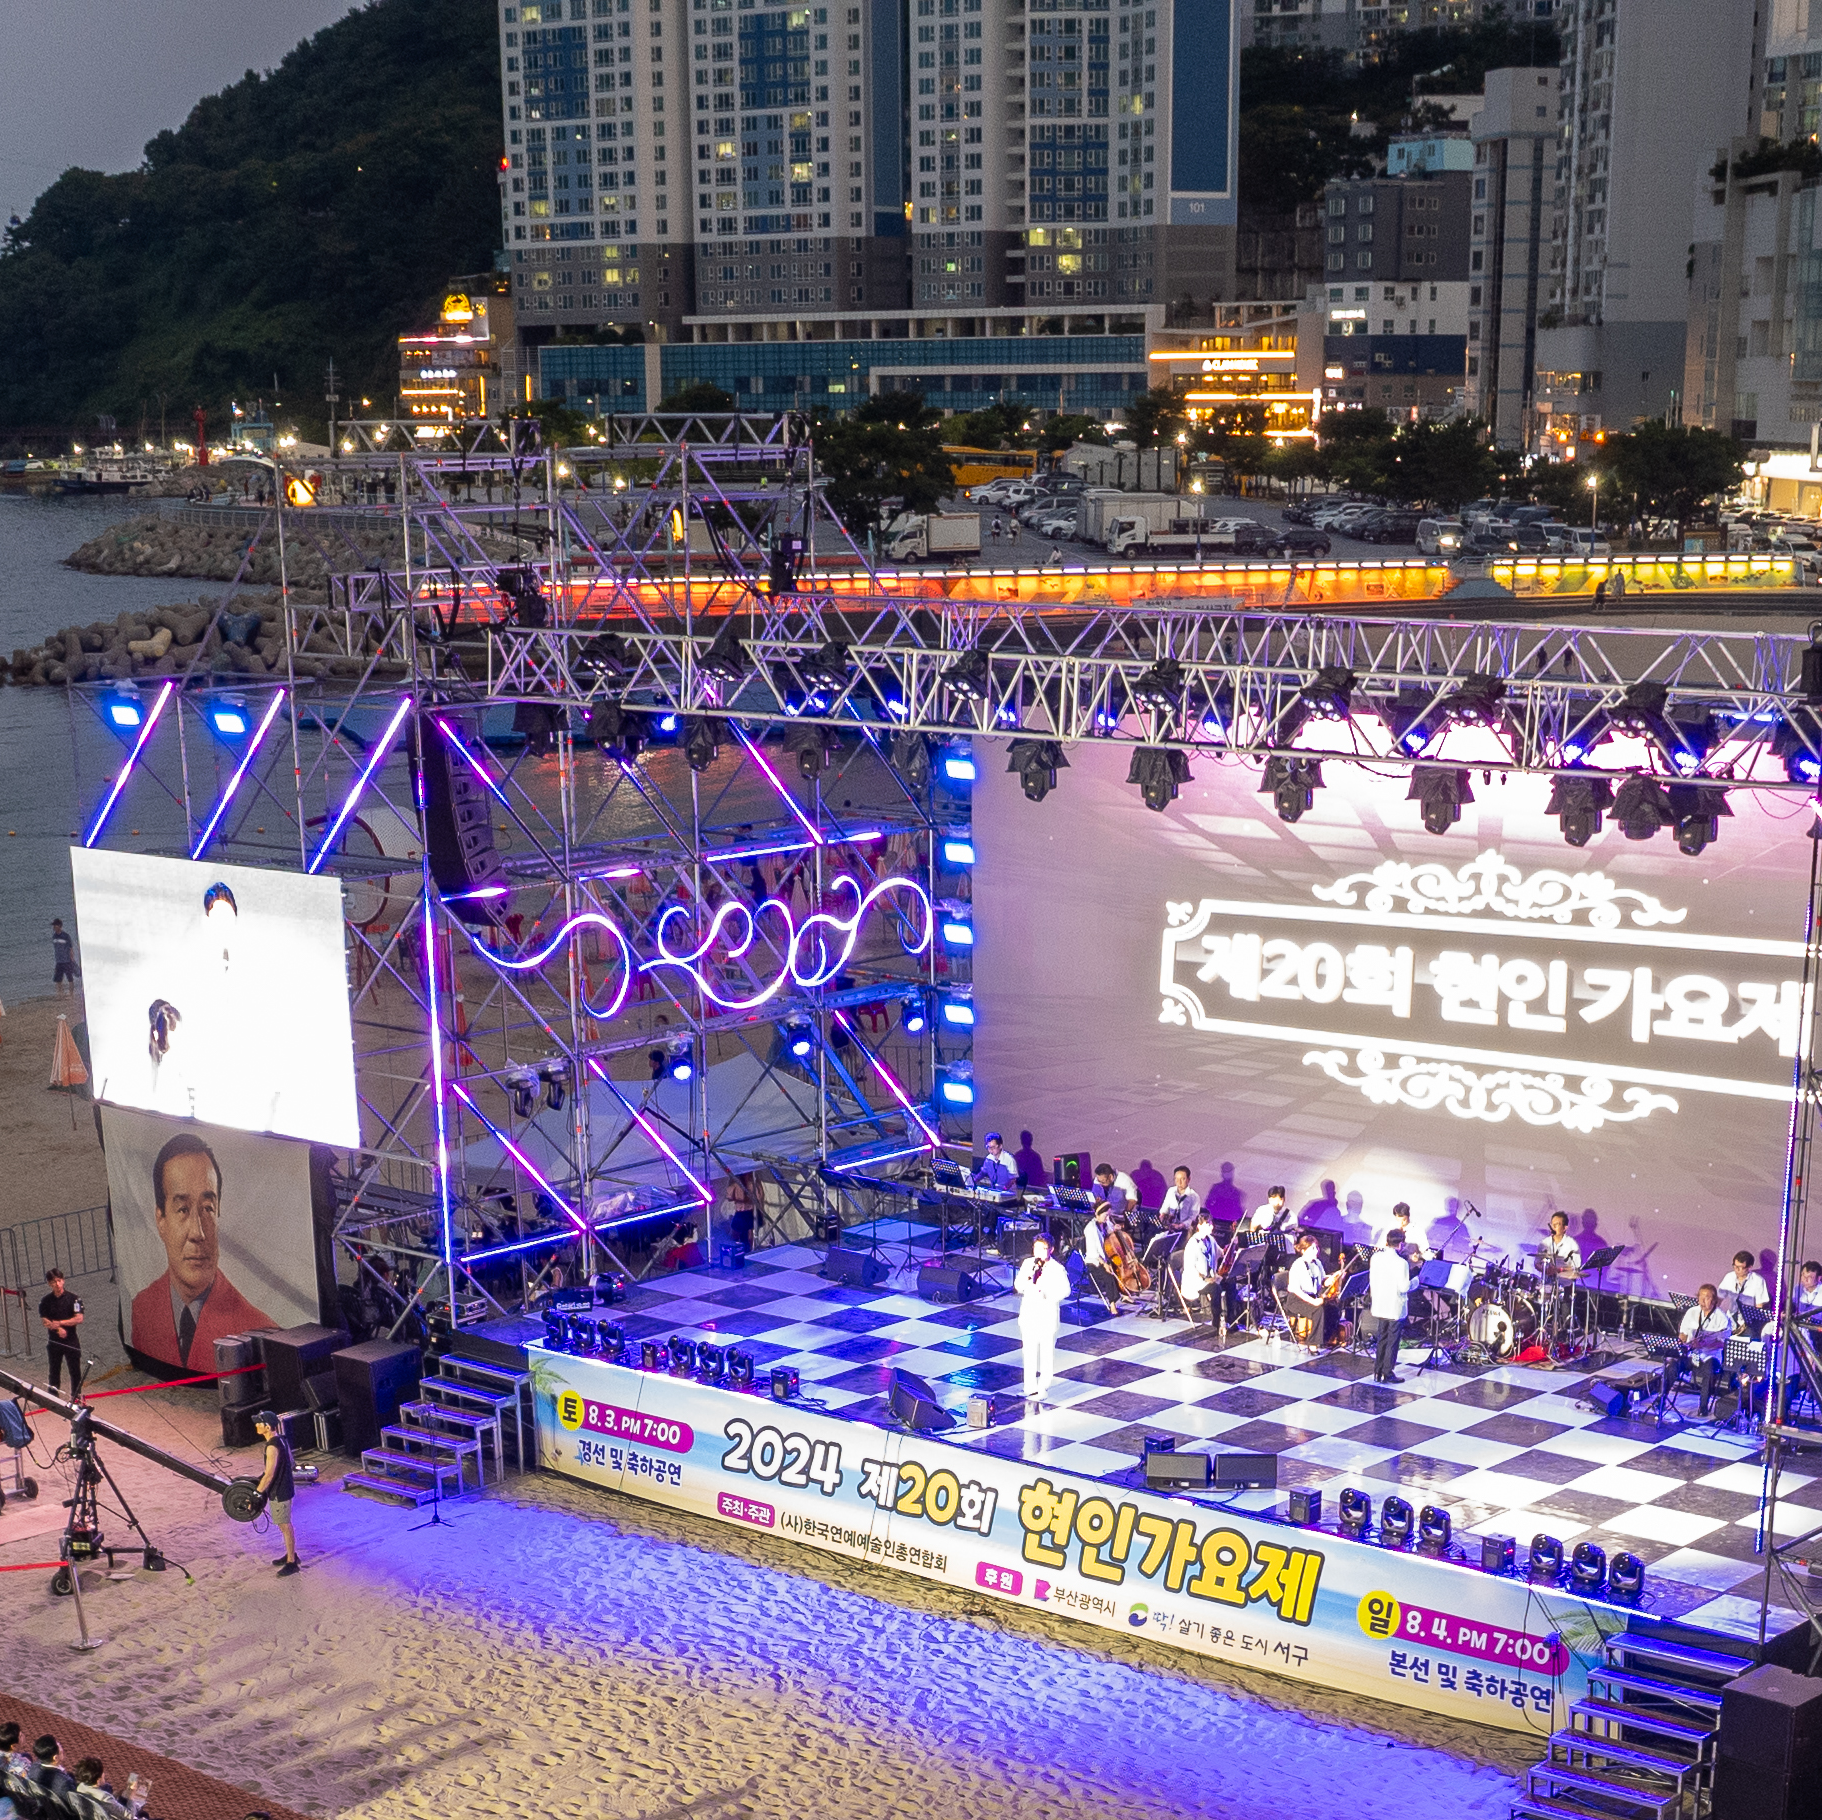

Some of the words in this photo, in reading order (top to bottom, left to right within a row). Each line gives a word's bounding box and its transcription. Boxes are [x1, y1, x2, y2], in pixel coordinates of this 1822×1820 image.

[1197, 930, 1415, 1018] 제20회
[1432, 951, 1572, 1035] 현인
[1575, 962, 1815, 1057] 가요제
[562, 1396, 578, 1423] 토
[588, 1404, 602, 1427] 8.
[605, 1410, 618, 1431] 3.
[621, 1416, 640, 1435] PM
[643, 1418, 681, 1445] 7:00
[579, 1439, 606, 1466] 경선
[610, 1447, 623, 1471] 및
[627, 1452, 682, 1487] 축하공연
[721, 1496, 772, 1524] 주최·주관
[721, 1418, 844, 1496] 2024
[858, 1458, 998, 1537] 제20회
[1019, 1478, 1326, 1626] 현인가요제
[780, 1511, 948, 1573] (사)한국연예예술인총연합회
[984, 1568, 1014, 1592] 후원
[1053, 1586, 1117, 1618] 부산광역시
[1368, 1598, 1394, 1635] 일
[1406, 1610, 1426, 1638] 8.
[1431, 1617, 1452, 1644] 4.
[1458, 1627, 1488, 1650] PM
[1492, 1631, 1550, 1665] 7:00
[1178, 1618, 1205, 1638] 살기
[1210, 1626, 1236, 1646] 좋은
[1241, 1634, 1269, 1656] 도시
[1273, 1640, 1309, 1667] 서구
[1389, 1650, 1430, 1684] 본선
[1437, 1662, 1458, 1691] 및
[1464, 1669, 1552, 1714] 축하공연
